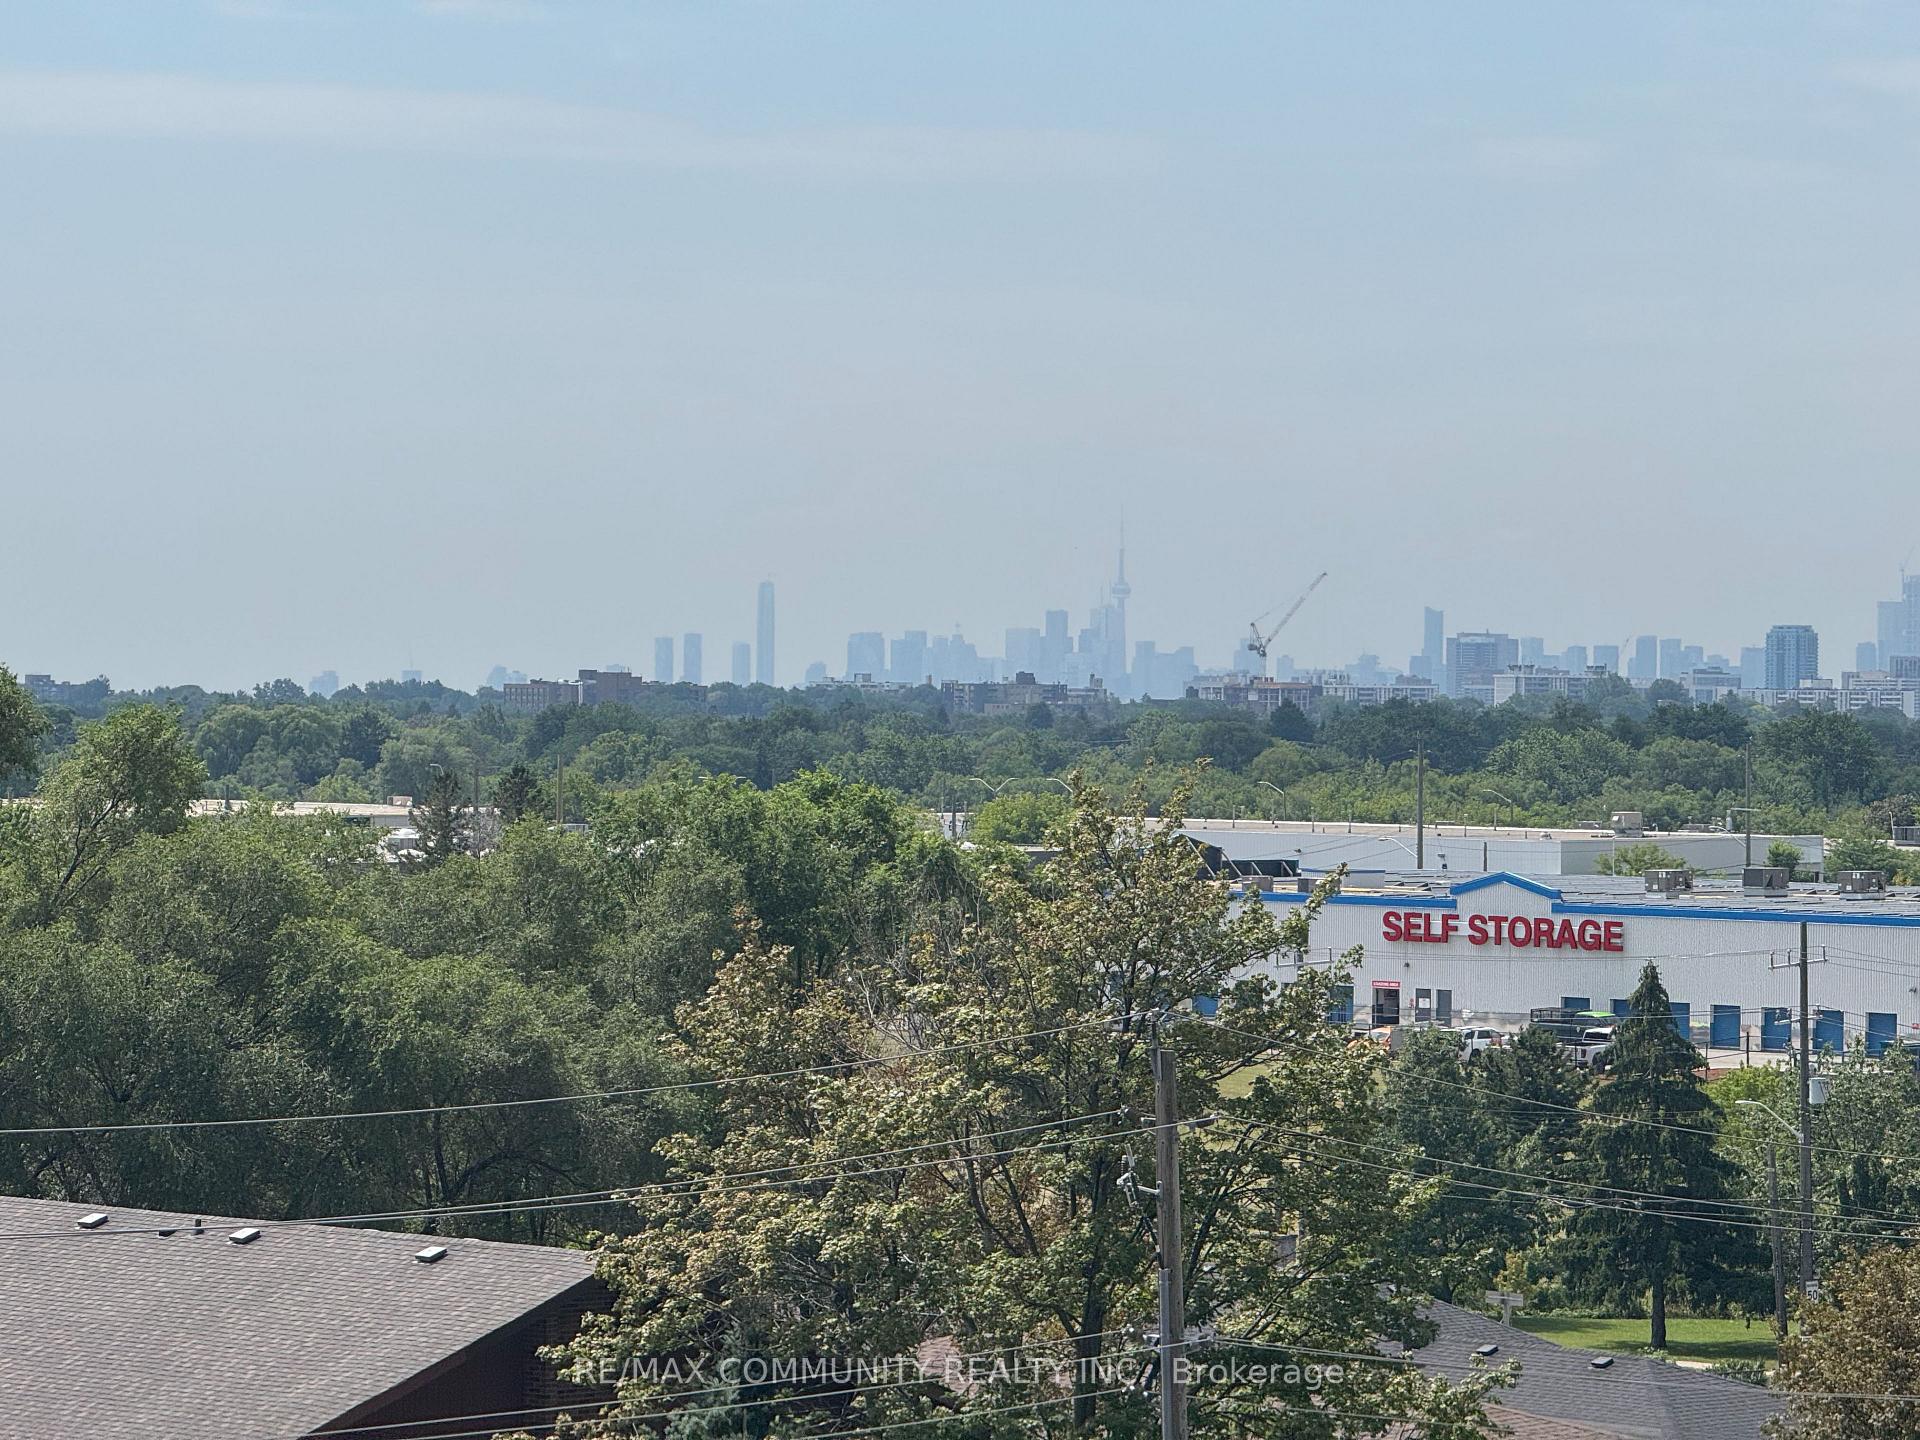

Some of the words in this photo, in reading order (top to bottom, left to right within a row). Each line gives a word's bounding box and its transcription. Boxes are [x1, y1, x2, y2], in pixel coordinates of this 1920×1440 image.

[1383, 911, 1459, 943] SELF
[1468, 914, 1624, 952] STORAGE
[1807, 1290, 1818, 1300] 50
